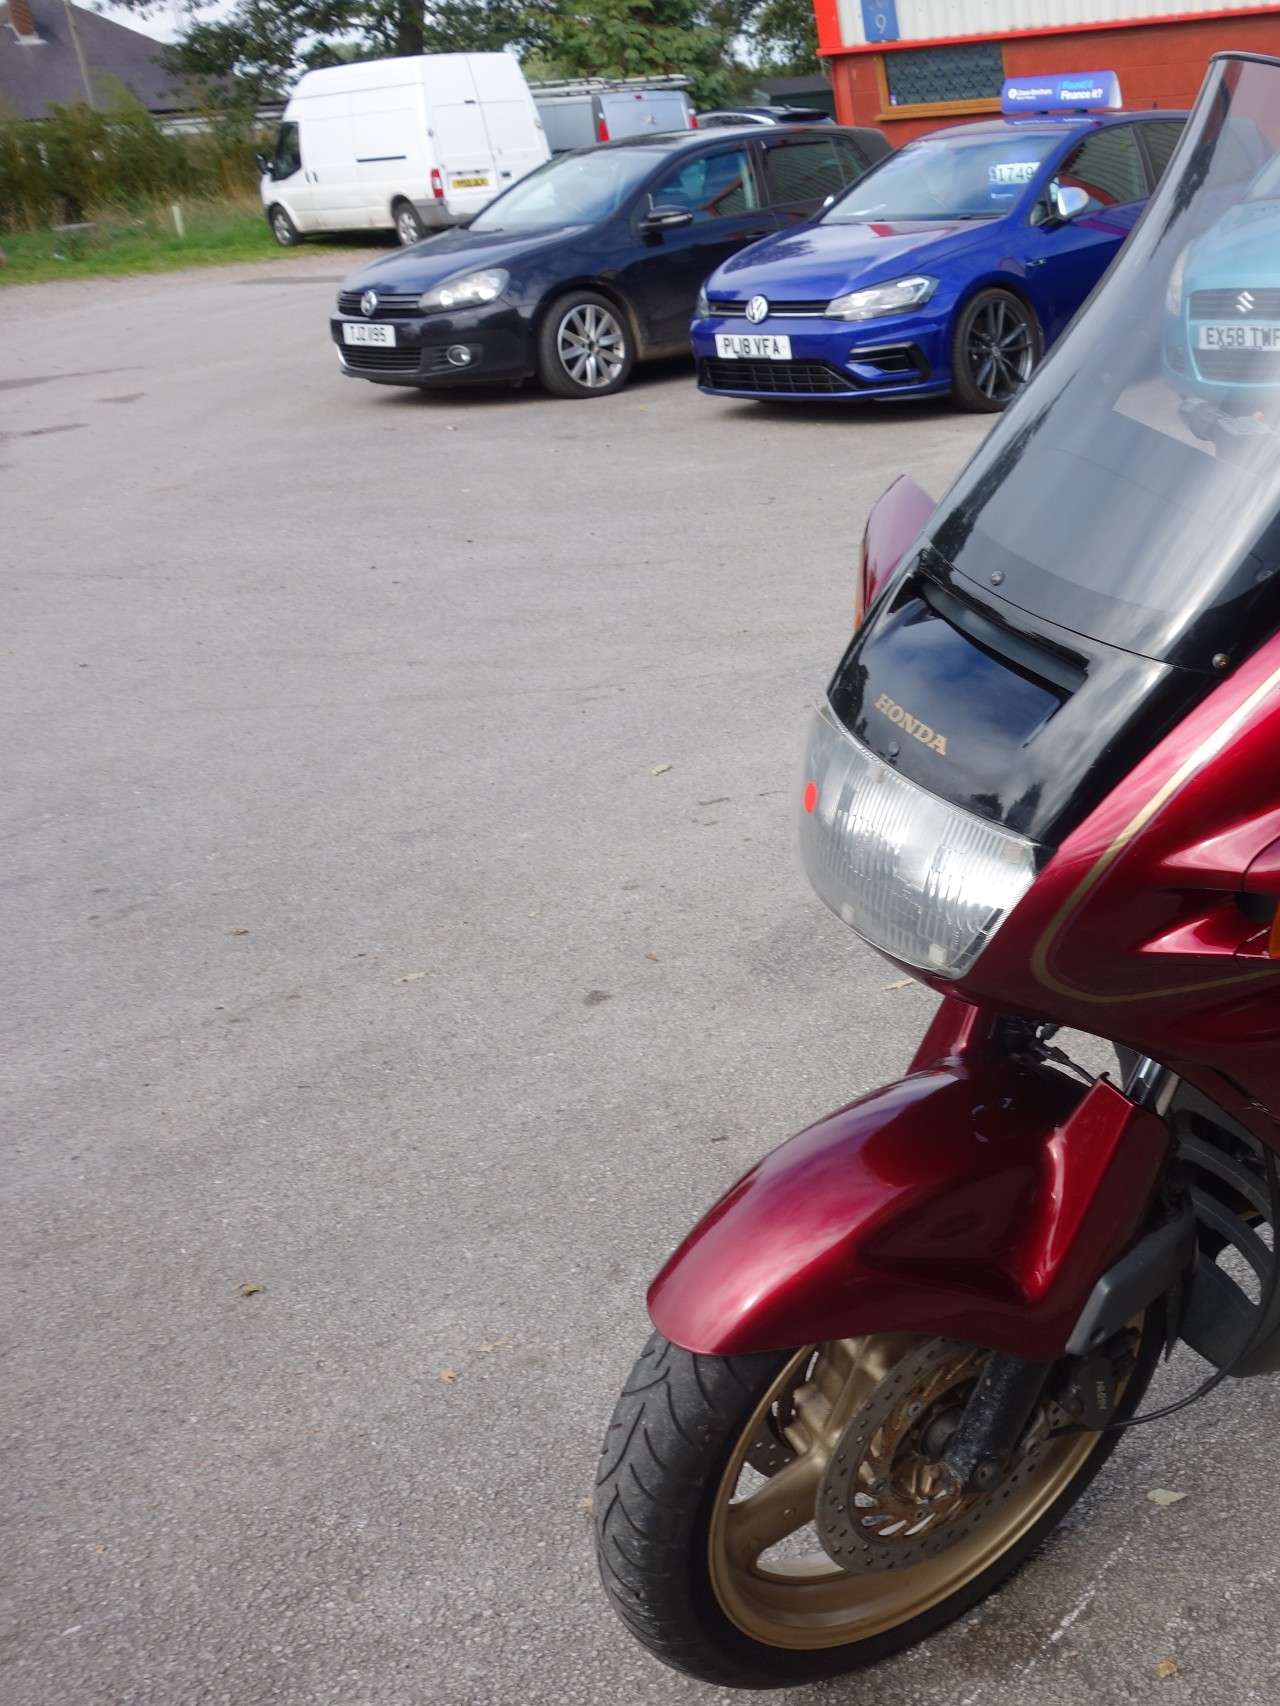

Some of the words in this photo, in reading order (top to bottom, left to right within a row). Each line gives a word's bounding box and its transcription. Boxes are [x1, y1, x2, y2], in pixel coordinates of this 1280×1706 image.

[1060, 89, 1091, 100] Finance
[722, 337, 752, 354] PL18
[753, 337, 781, 354] VFA
[1206, 327, 1246, 346] EX58
[874, 692, 947, 756] HONDA
